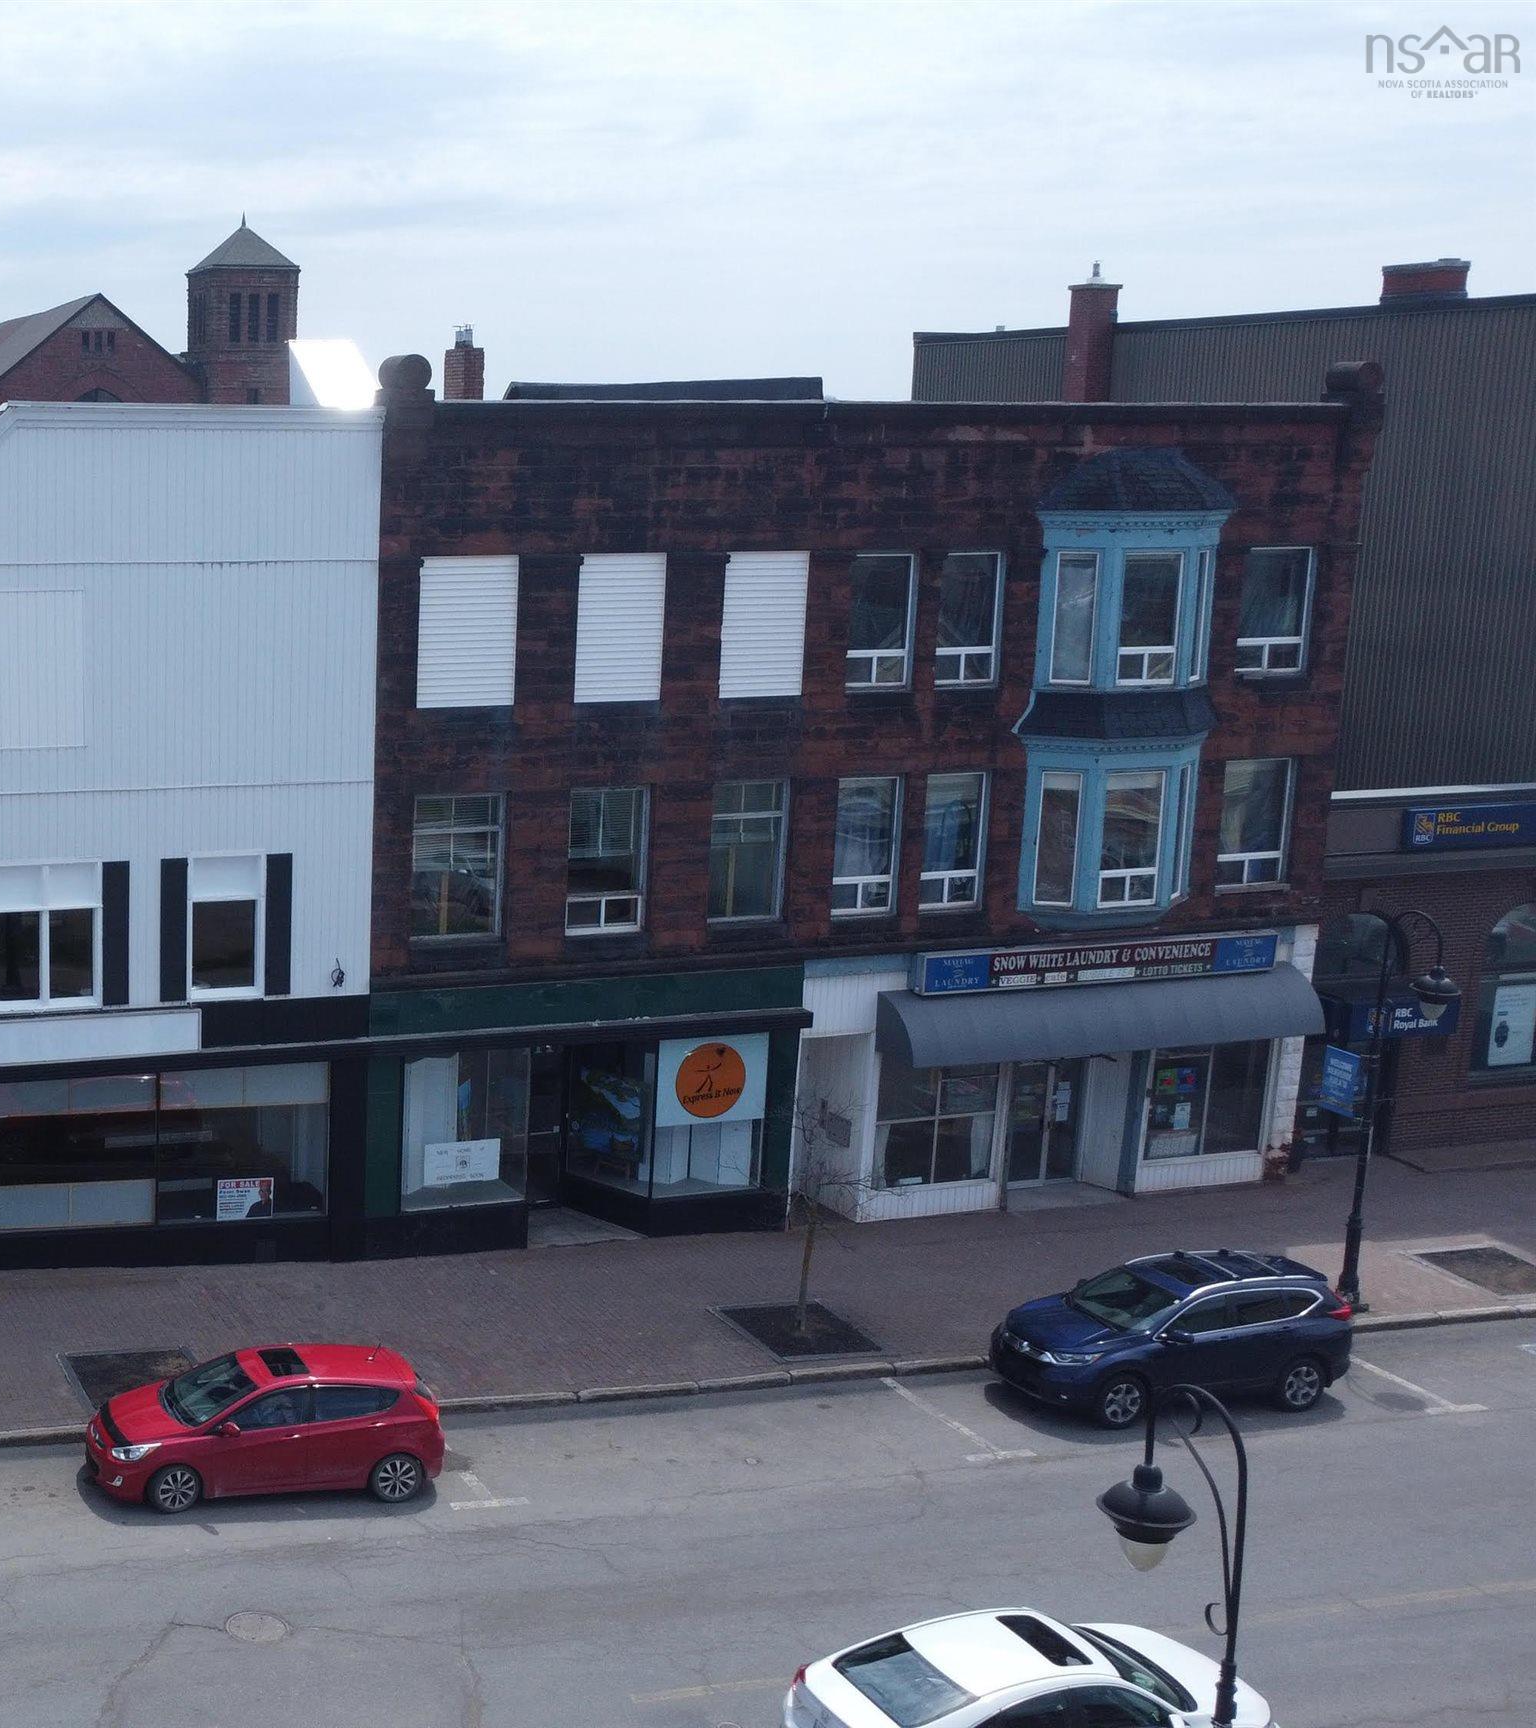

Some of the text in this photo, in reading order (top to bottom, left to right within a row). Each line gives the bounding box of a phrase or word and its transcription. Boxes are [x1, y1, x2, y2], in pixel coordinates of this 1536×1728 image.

[1438, 812, 1461, 822] RBC
[1436, 821, 1519, 835] Financial Group
[994, 943, 1212, 971] SNOW WHITE LAUNDRY & CONVENIENCE
[1000, 974, 1036, 986] VEGGIE
[1142, 966, 1168, 976] LOTTO
[1171, 963, 1202, 974] TICKETS
[935, 976, 979, 987] LAUNDRY
[1395, 1008, 1413, 1018] RBC
[1394, 1018, 1438, 1031] Royal Bank
[220, 1181, 236, 1189] FOR
